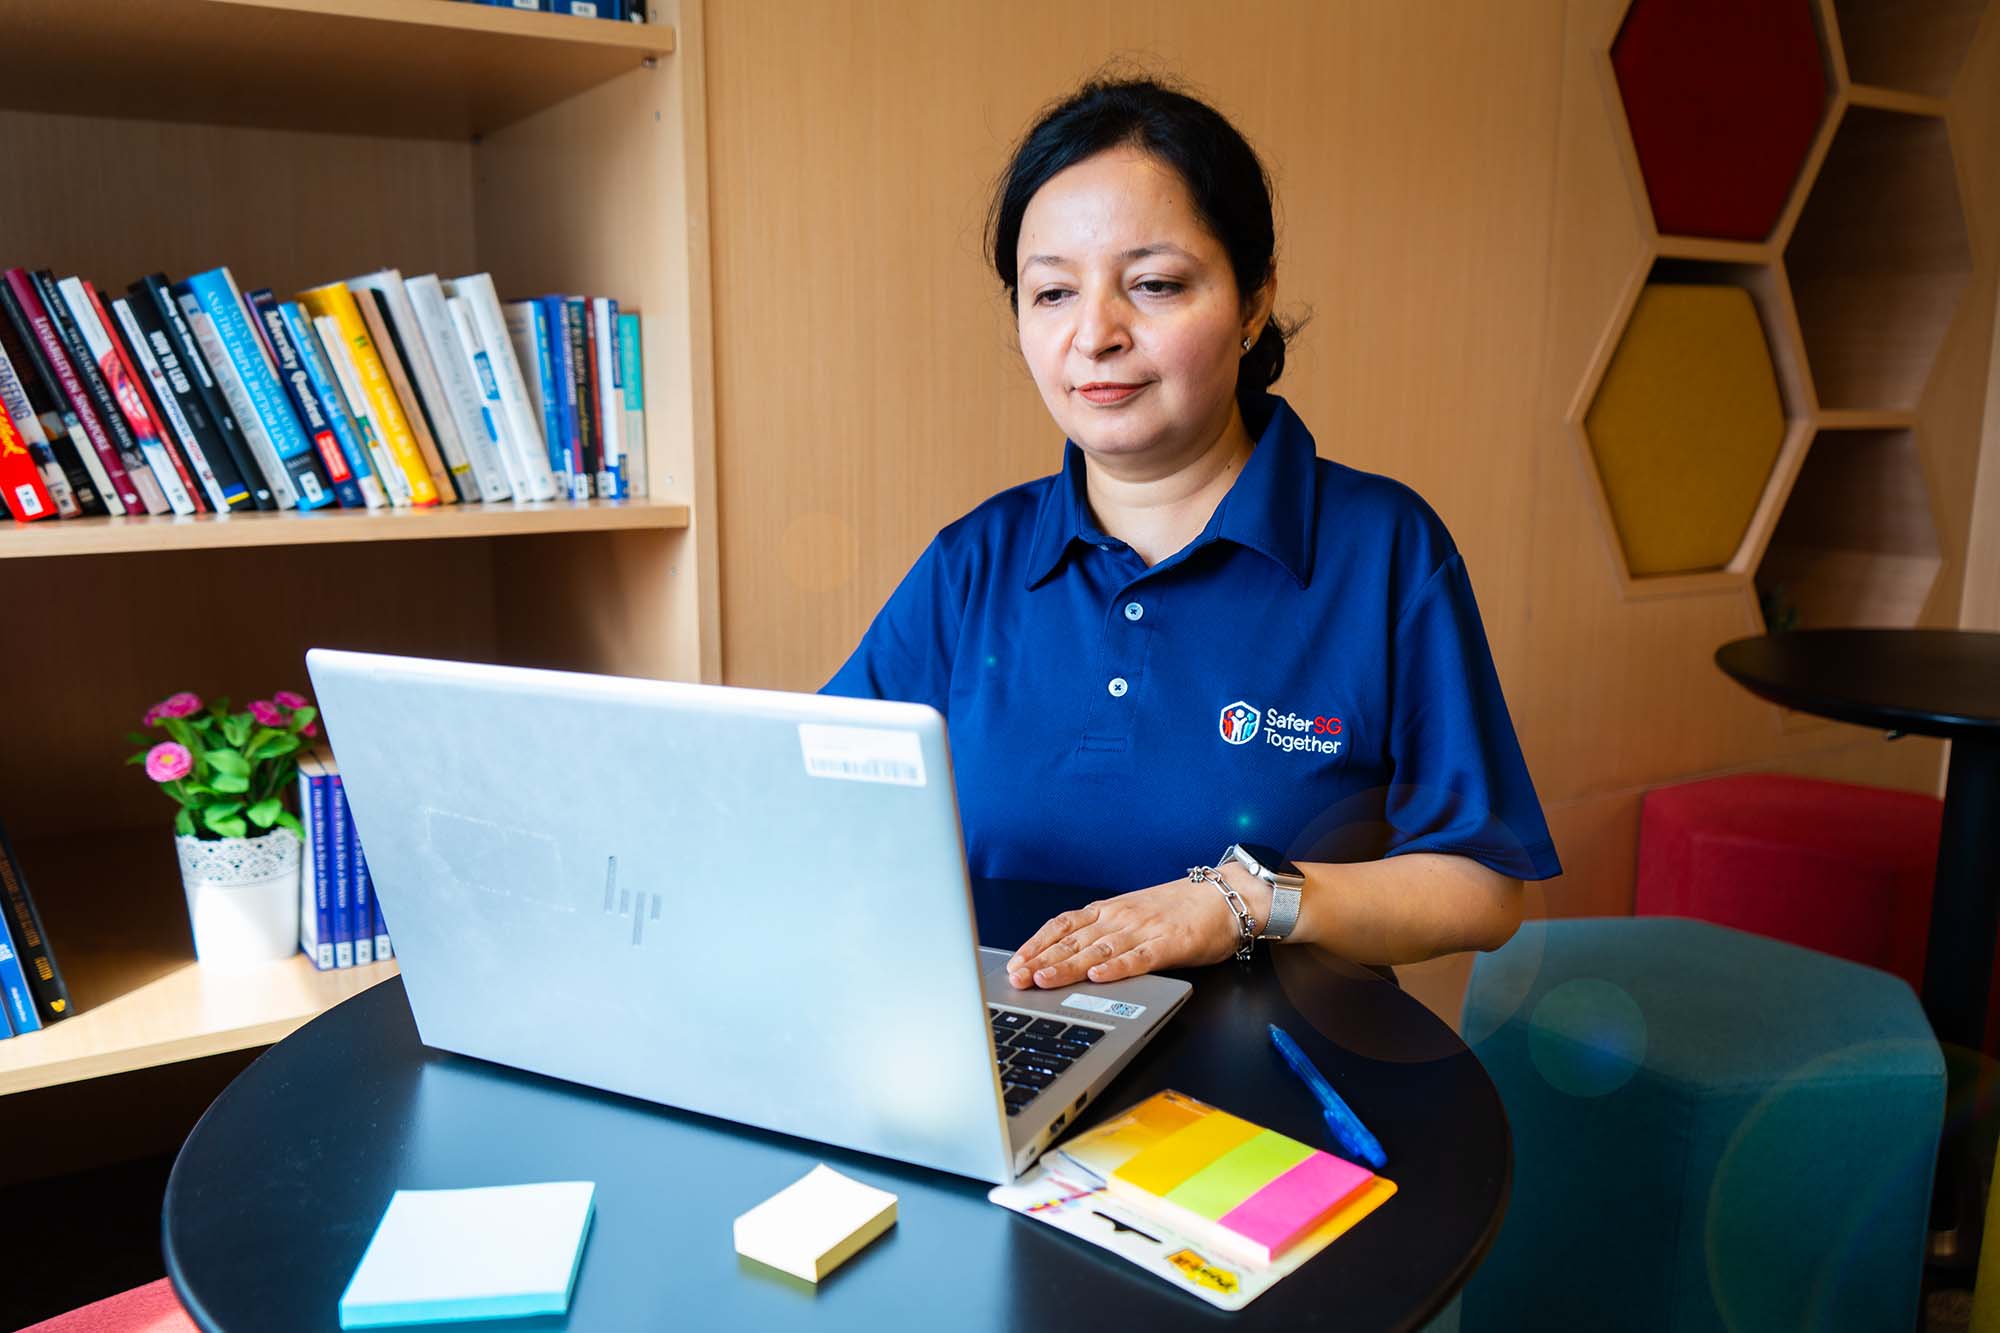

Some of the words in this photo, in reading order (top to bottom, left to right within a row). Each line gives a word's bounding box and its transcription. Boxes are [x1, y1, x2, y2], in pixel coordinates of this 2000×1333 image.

[260, 307, 300, 373] Adversity
[288, 368, 327, 430] Quotient
[1266, 708, 1342, 735] SaferSG
[1263, 728, 1342, 754] Together
